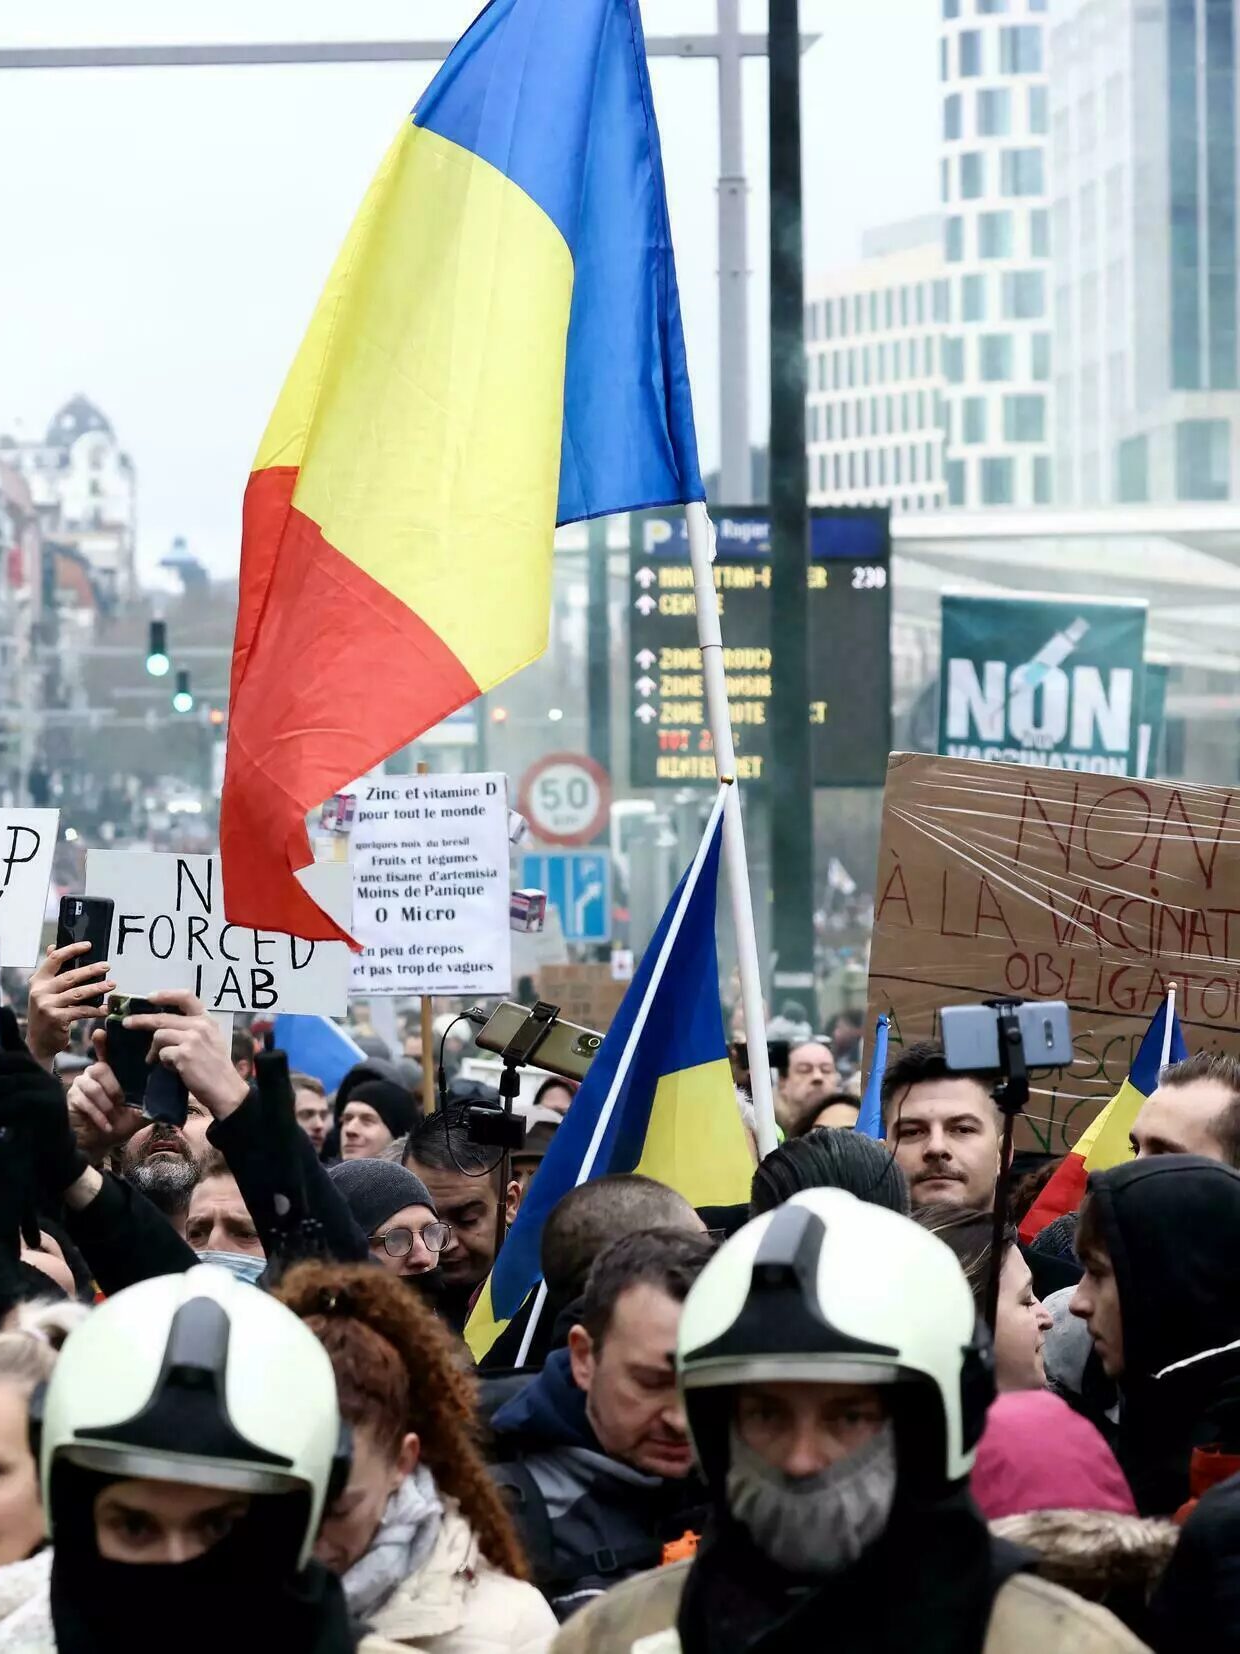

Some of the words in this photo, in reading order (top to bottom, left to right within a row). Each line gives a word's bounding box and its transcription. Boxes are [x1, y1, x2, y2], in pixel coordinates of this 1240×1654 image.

[946, 658, 1133, 752] NON
[366, 786, 400, 801] Zinc
[405, 787, 420, 800] et
[423, 786, 480, 799] vitamine
[485, 782, 498, 796] D
[539, 777, 589, 810] 50
[359, 809, 389, 822] pour
[394, 808, 421, 819] tout
[425, 808, 437, 819] le
[441, 805, 486, 818] monde
[1014, 780, 1234, 890] NON
[371, 855, 406, 866] Fruits
[411, 855, 421, 865] et
[176, 858, 213, 914] N
[360, 874, 382, 883] une
[386, 872, 422, 882] tisane
[357, 887, 399, 899] Moins
[404, 885, 421, 898] de
[424, 884, 485, 900] Panique
[875, 848, 914, 926] À
[940, 869, 1018, 948] LA
[116, 914, 315, 970] FORCED
[380, 947, 403, 958] peu
[408, 944, 424, 956] de
[426, 945, 464, 958] repos
[353, 965, 365, 975] et
[370, 966, 392, 977] pas
[397, 964, 425, 976] trop
[427, 962, 443, 973] de
[447, 962, 494, 974] vagues
